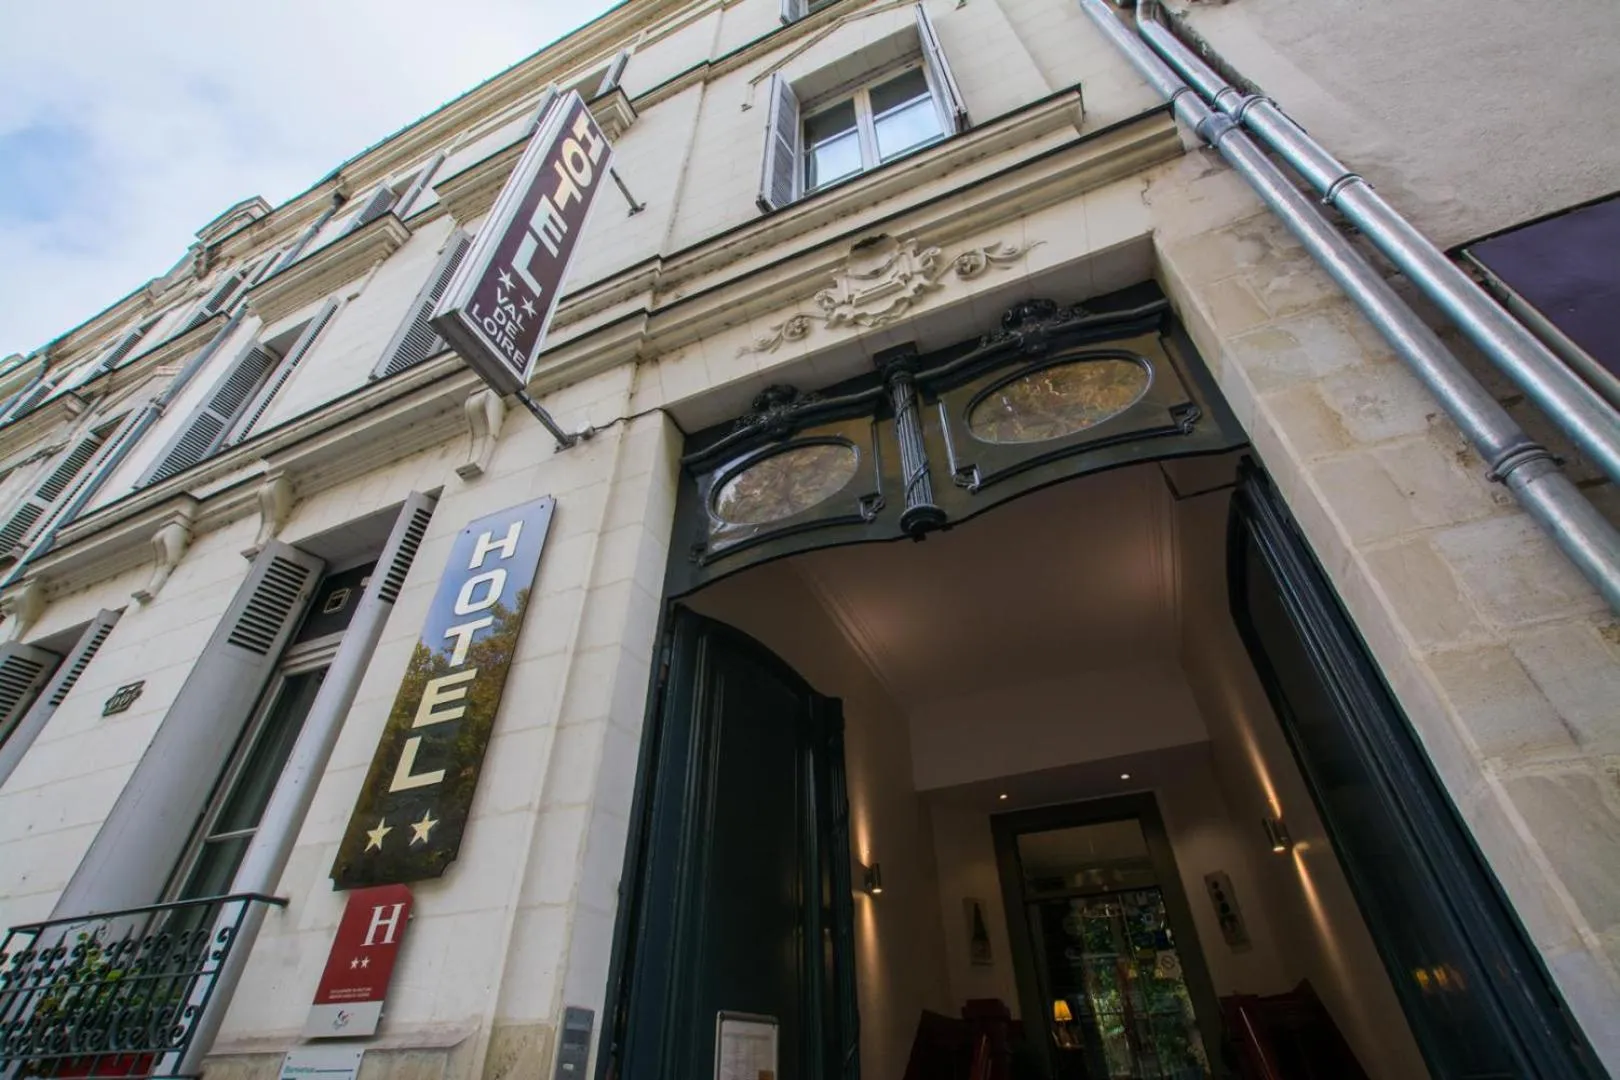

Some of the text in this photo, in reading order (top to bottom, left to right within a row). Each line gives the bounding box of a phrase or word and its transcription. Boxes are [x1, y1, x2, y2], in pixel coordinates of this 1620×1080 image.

[511, 108, 605, 298] HOTEL
[471, 303, 526, 368] LOIRE
[493, 306, 518, 340] DE
[497, 287, 525, 332] VAL
[388, 519, 523, 793] HOTEL
[360, 902, 406, 946] H
